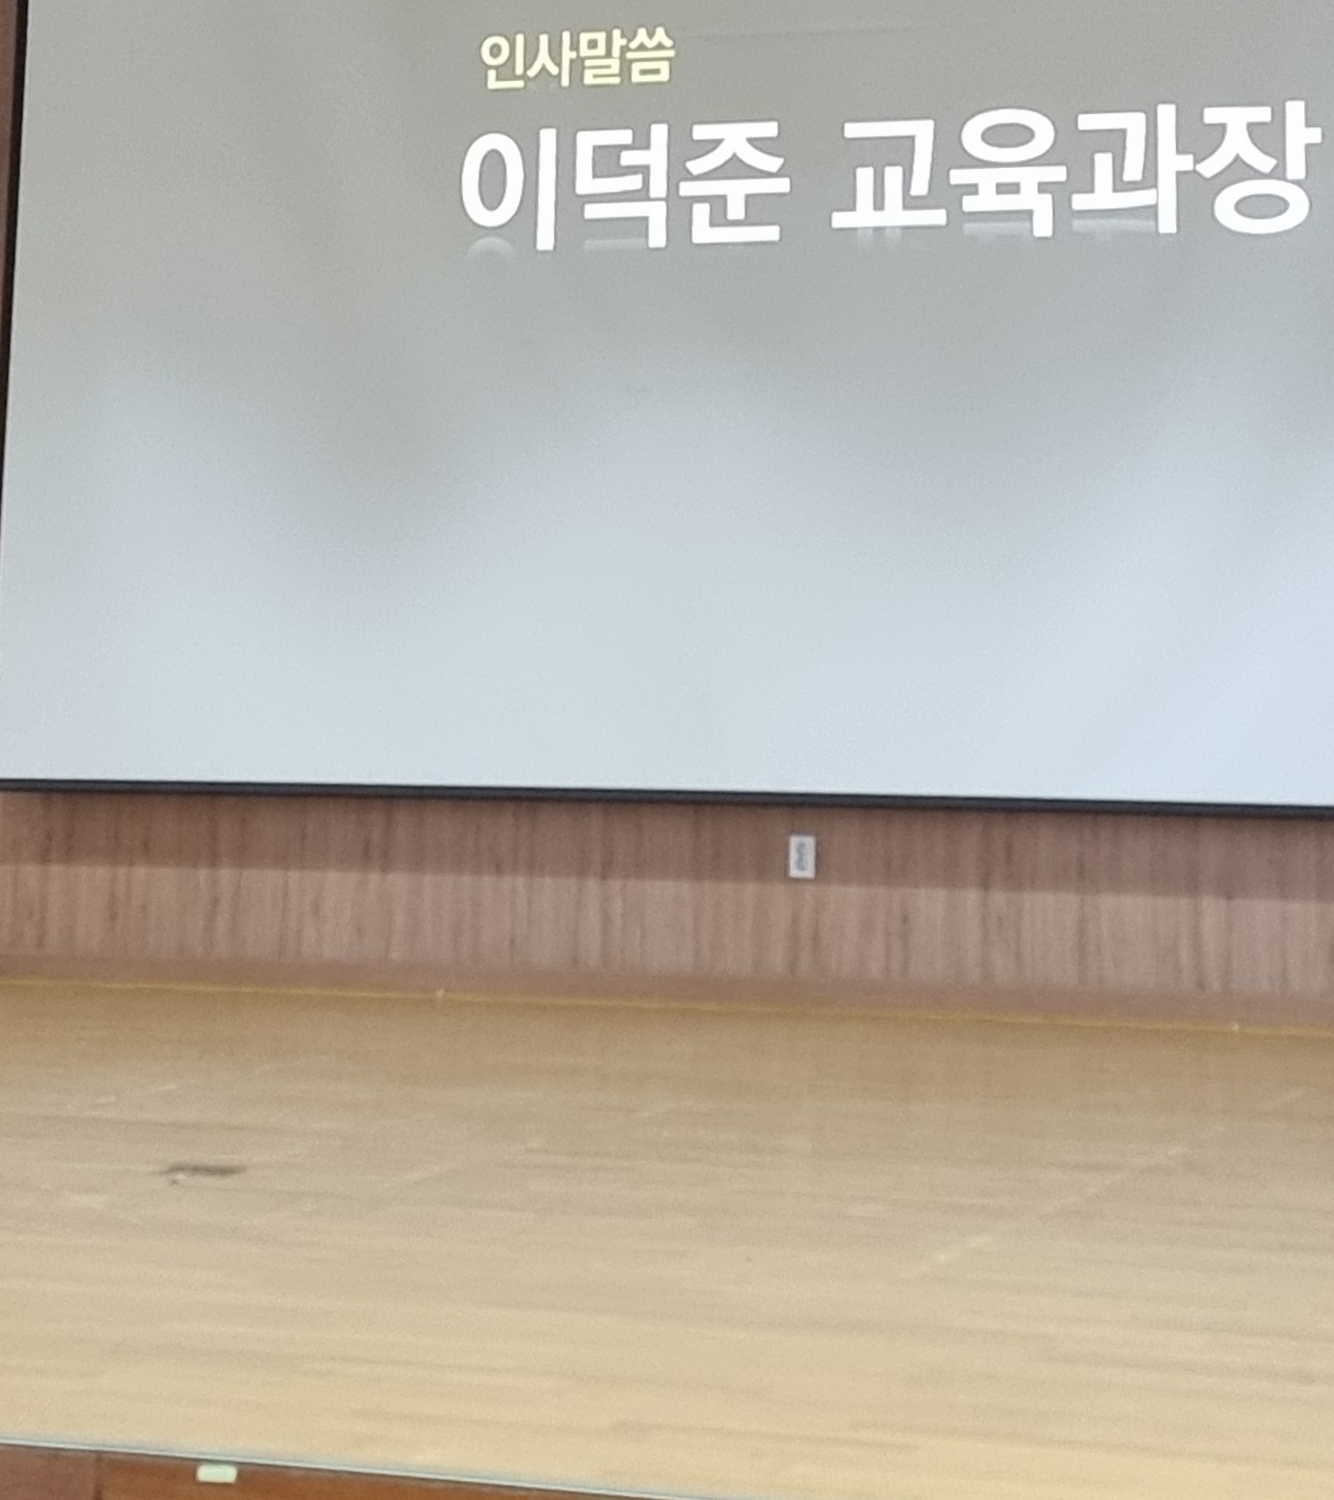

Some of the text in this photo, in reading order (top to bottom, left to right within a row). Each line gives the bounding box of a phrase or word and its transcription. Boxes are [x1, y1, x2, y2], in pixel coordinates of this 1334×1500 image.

[480, 26, 676, 90] 인사말씀
[461, 100, 1322, 251] 이덕준 교육과장
